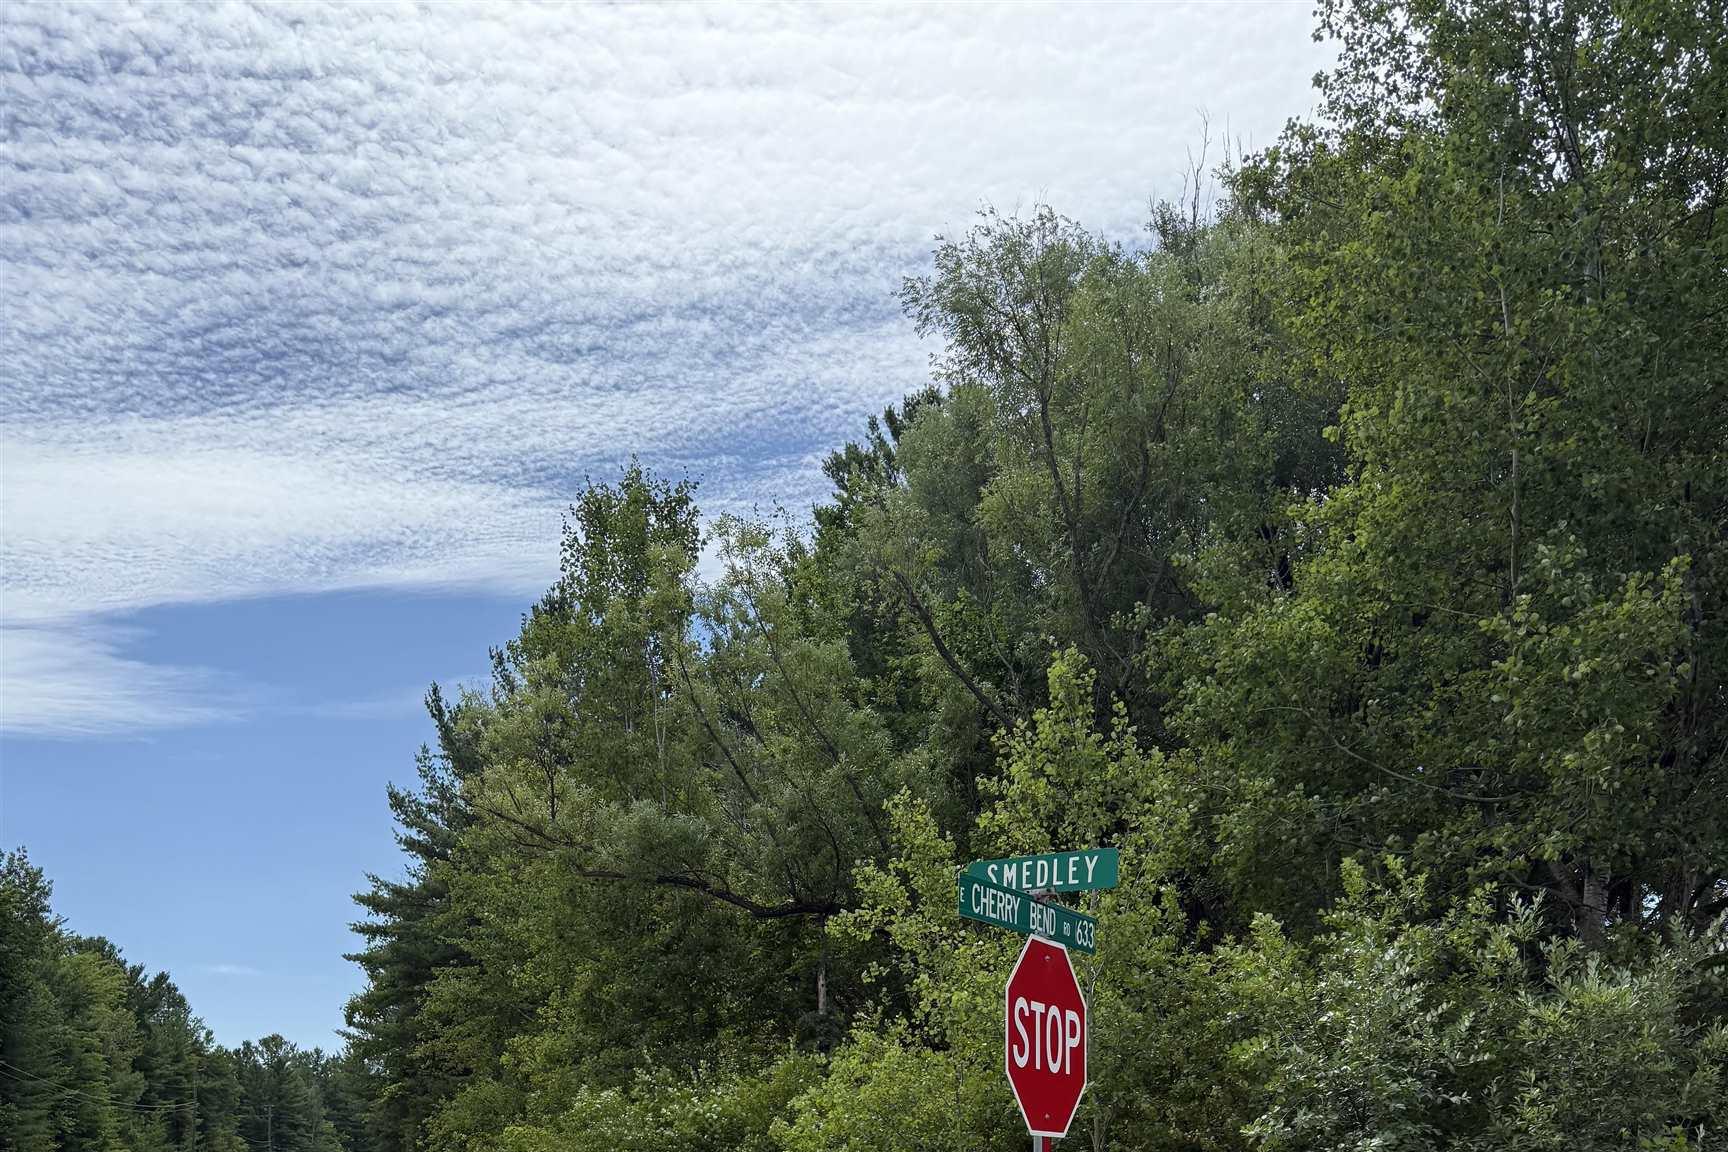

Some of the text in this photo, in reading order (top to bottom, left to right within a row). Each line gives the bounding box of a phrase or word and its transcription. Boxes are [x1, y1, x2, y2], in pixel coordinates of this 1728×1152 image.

[960, 886, 966, 903] E
[971, 883, 1021, 925] CHERRY
[1029, 901, 1057, 936] BEND
[1063, 921, 1071, 937] RD
[1012, 996, 1081, 1075] STOP
